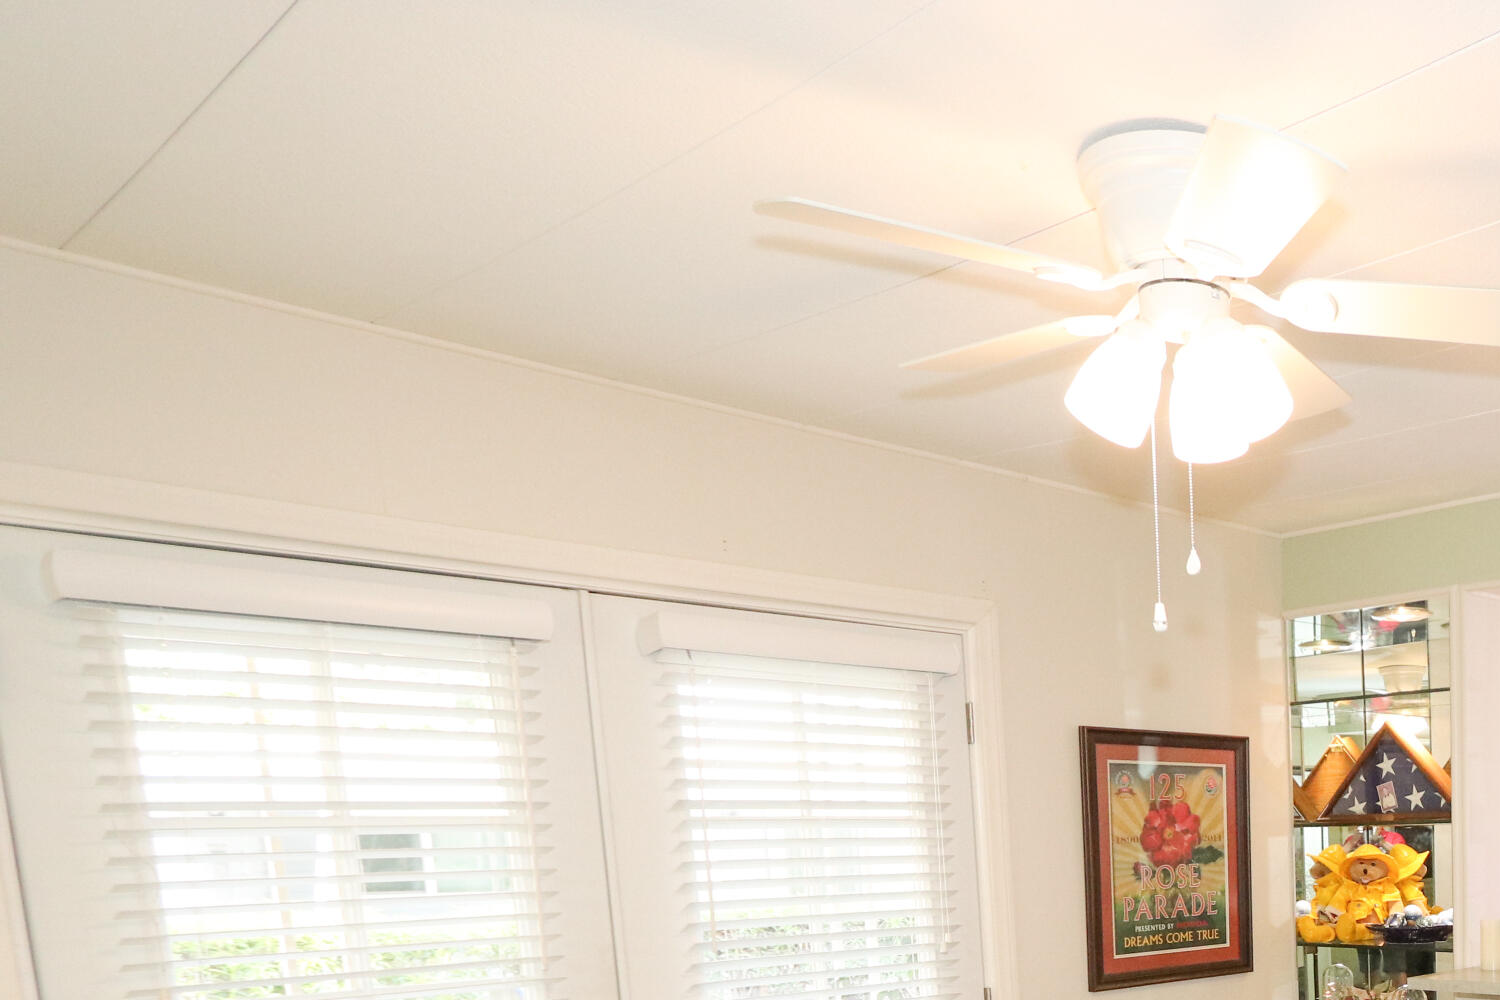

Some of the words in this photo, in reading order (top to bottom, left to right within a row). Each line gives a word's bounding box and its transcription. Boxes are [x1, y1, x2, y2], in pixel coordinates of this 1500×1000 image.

[1149, 773, 1185, 801] 125
[1140, 863, 1201, 891] ROSE
[1123, 891, 1218, 922] PARADE
[1124, 934, 1163, 948] DREAMS
[1166, 930, 1194, 943] COME
[1197, 928, 1220, 941] TRUE
[1135, 923, 1165, 933] PRESENTED
[1167, 922, 1175, 930] BY
